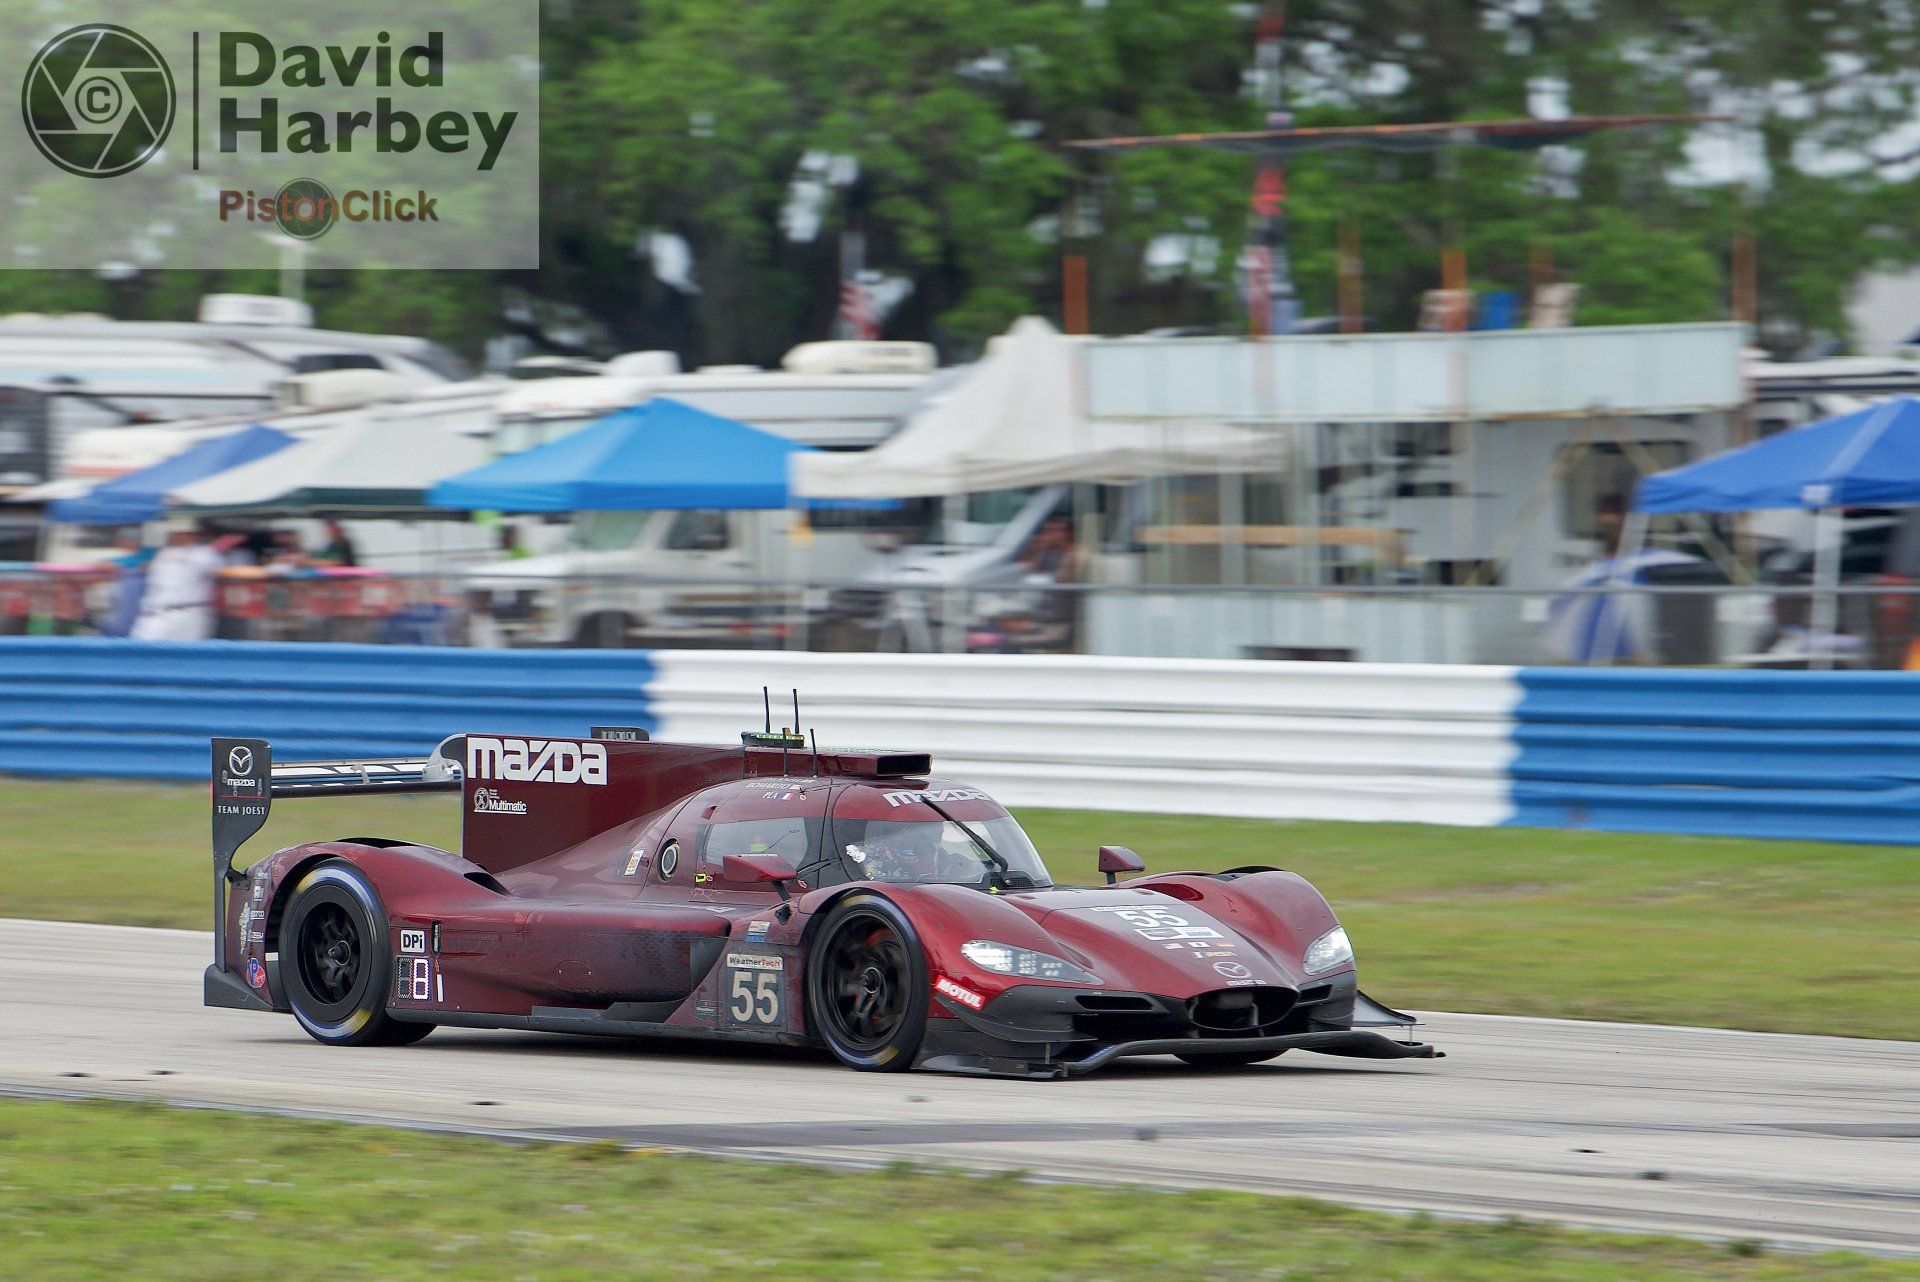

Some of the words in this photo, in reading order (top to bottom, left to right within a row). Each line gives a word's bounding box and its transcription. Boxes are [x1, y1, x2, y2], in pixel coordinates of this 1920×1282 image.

[217, 805, 240, 814] TEAM
[242, 806, 265, 816] JOEST
[488, 799, 527, 812] Multimatic
[1113, 909, 1190, 928] 55
[402, 933, 423, 949] DPi
[728, 956, 781, 967] WeatherTech
[730, 971, 779, 1024] 55
[936, 978, 982, 1008] MOTUL
